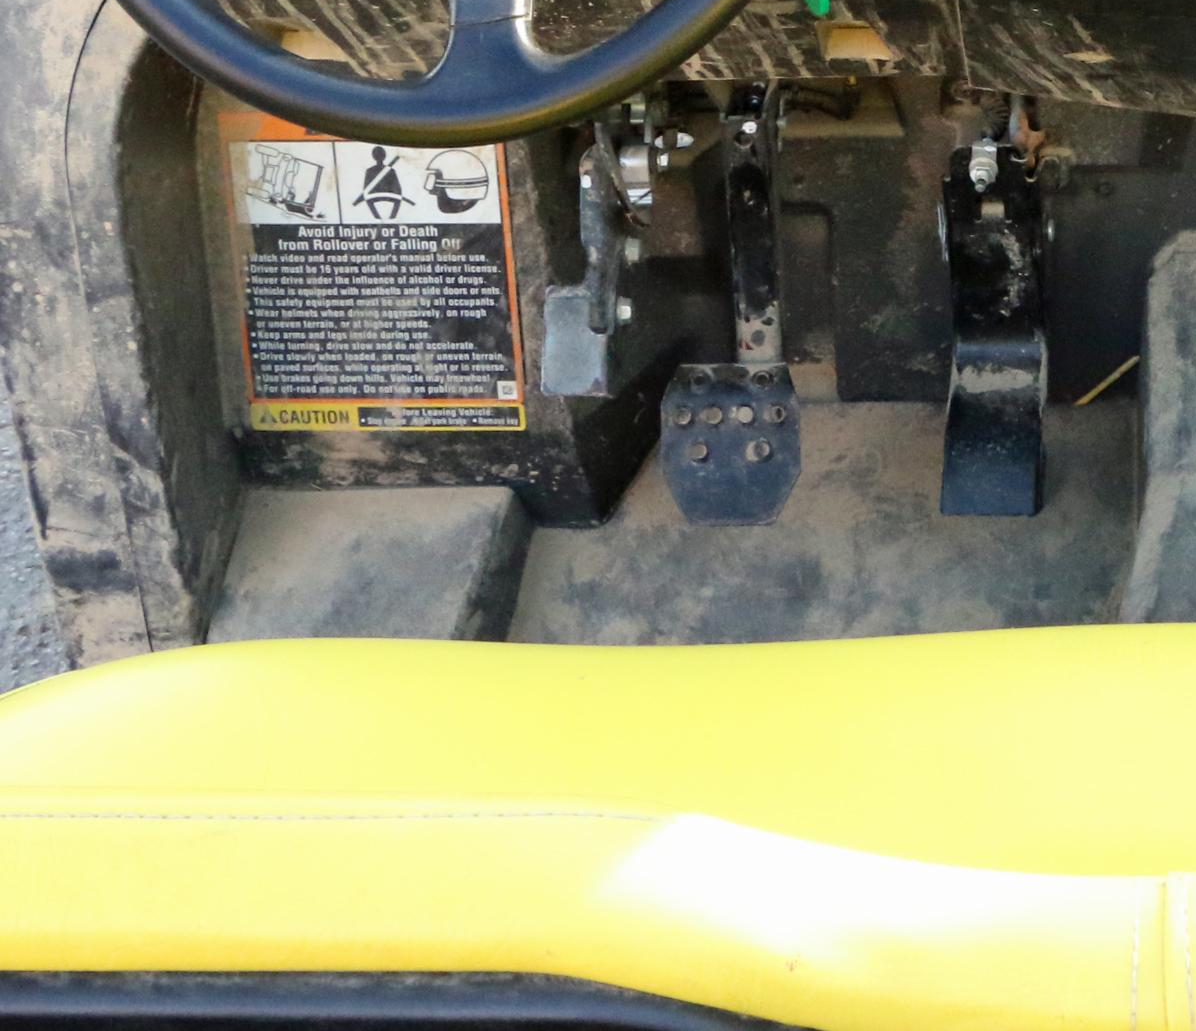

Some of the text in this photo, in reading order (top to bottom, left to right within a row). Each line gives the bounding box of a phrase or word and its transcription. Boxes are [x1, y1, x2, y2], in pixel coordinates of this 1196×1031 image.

[298, 226, 438, 239] Avoid Injury or Death
[278, 238, 461, 252] from Rollover or Falling Off
[351, 254, 398, 263] operator's
[400, 254, 434, 262] manual
[251, 265, 277, 273] Driver
[281, 265, 303, 273] must
[306, 265, 317, 273] be
[320, 265, 331, 273] 16
[333, 266, 359, 274] years
[362, 265, 376, 273] old
[378, 265, 398, 273] with
[409, 265, 433, 273] valid
[435, 265, 461, 273] driver
[464, 265, 501, 273] license.
[252, 276, 486, 285] Never drive under the influence of alcohol or drugs.
[252, 287, 285, 295] Vehicle
[288, 287, 296, 295] is
[298, 287, 338, 296] equipped
[341, 287, 359, 295] with
[361, 287, 401, 295] seatbelts
[404, 287, 419, 295] and
[422, 287, 440, 295] side
[443, 287, 468, 295] doors
[352, 342, 373, 350] slow
[376, 342, 392, 350] and
[395, 342, 406, 350] do
[280, 410, 350, 424] CAUTION
